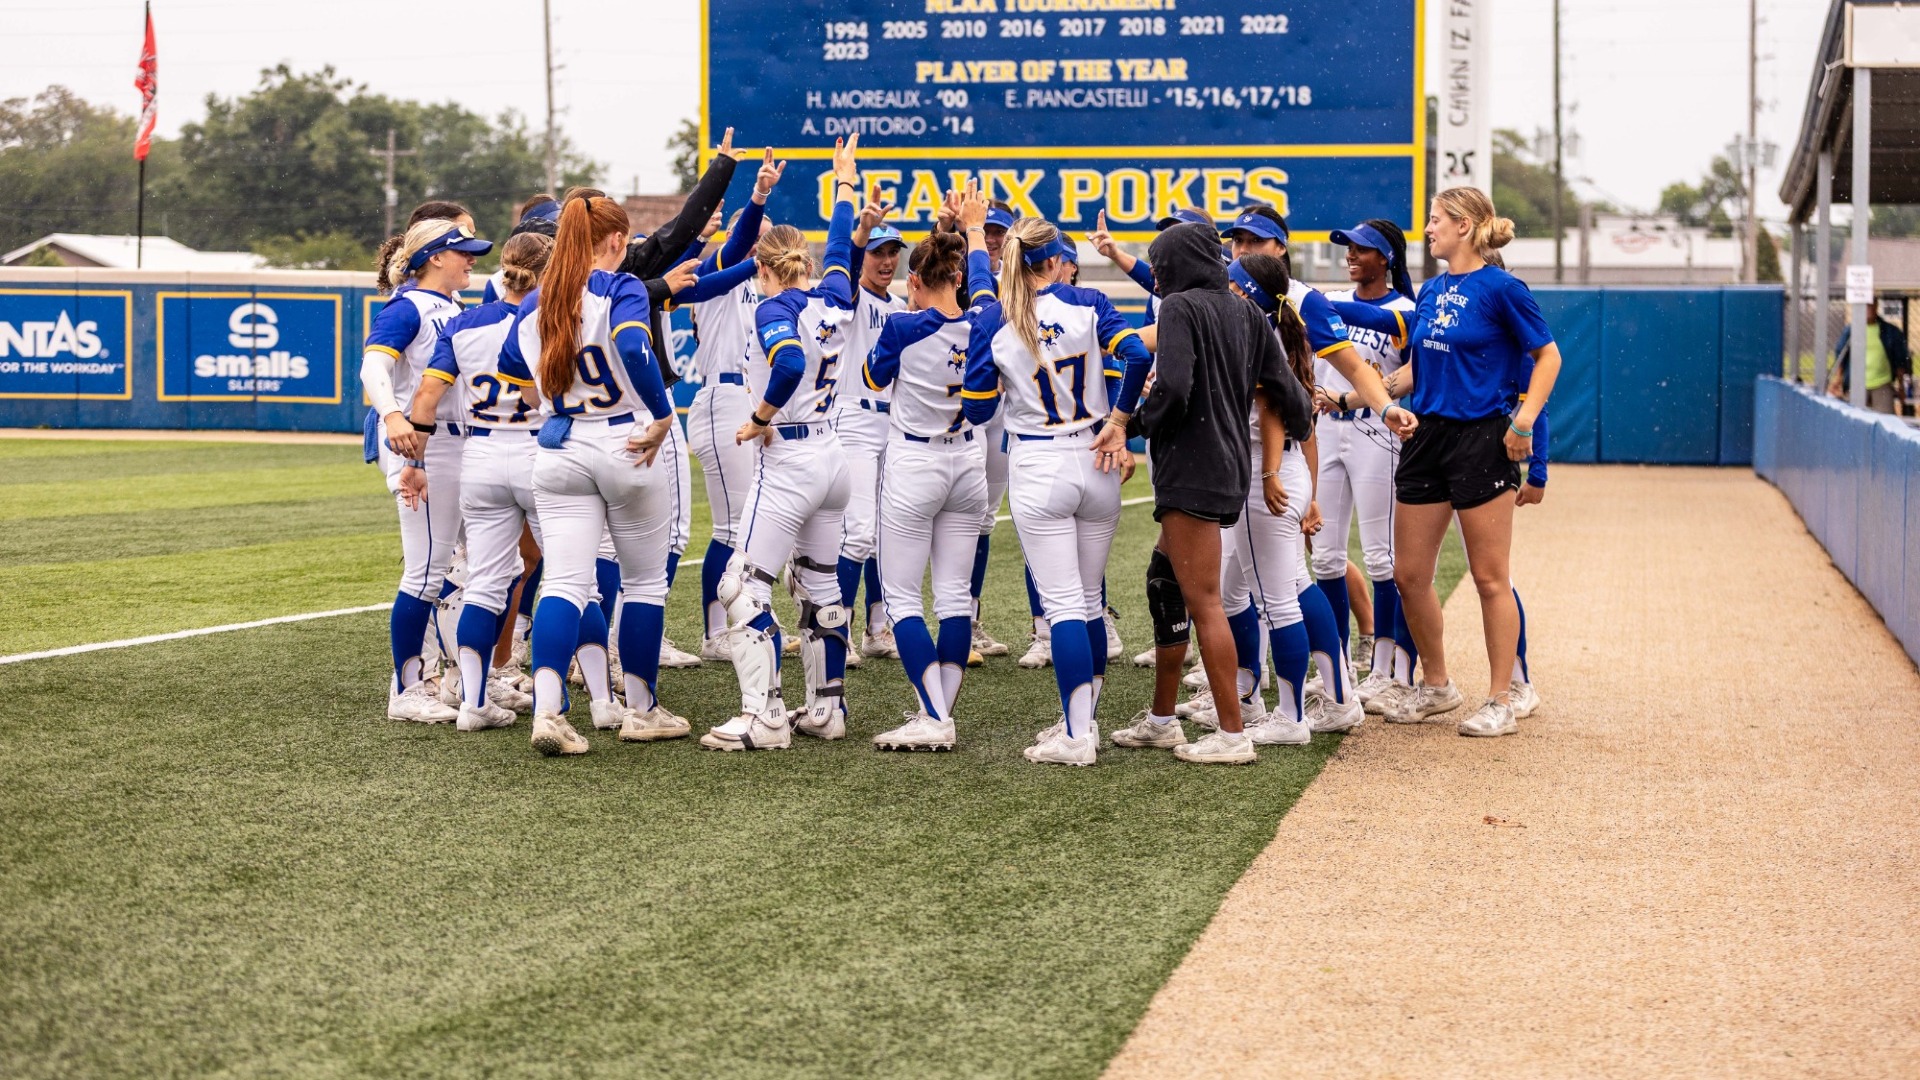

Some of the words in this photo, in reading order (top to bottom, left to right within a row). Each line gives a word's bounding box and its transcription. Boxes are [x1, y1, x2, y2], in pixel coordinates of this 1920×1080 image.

[925, 0, 998, 13] NCAA
[824, 22, 869, 40] 1994
[882, 20, 928, 39] 2005
[941, 20, 988, 38] 2010
[999, 19, 1046, 38] 2016
[1059, 18, 1107, 37] 2017
[1119, 17, 1166, 36] 2018
[1180, 16, 1225, 36] 2021
[1240, 15, 1289, 34] 2022
[823, 41, 869, 60] 2023
[915, 61, 1018, 83] PLAYER
[1021, 60, 1056, 82] OF
[1059, 59, 1113, 82] THE
[1115, 58, 1188, 81] YEAR
[806, 90, 827, 109] H.
[830, 89, 921, 109] MOREAUX
[1004, 88, 1022, 108] E.
[1026, 87, 1148, 108] PIANCASTELLI
[801, 117, 820, 136] A.
[818, 168, 1044, 222] GEAUX
[1059, 168, 1290, 223] POKES
[1423, 338, 1450, 353] SOFTBALL
[22, 362, 48, 373] THE
[194, 350, 309, 379] smalls
[814, 353, 838, 413] 5
[1032, 352, 1093, 427] 17
